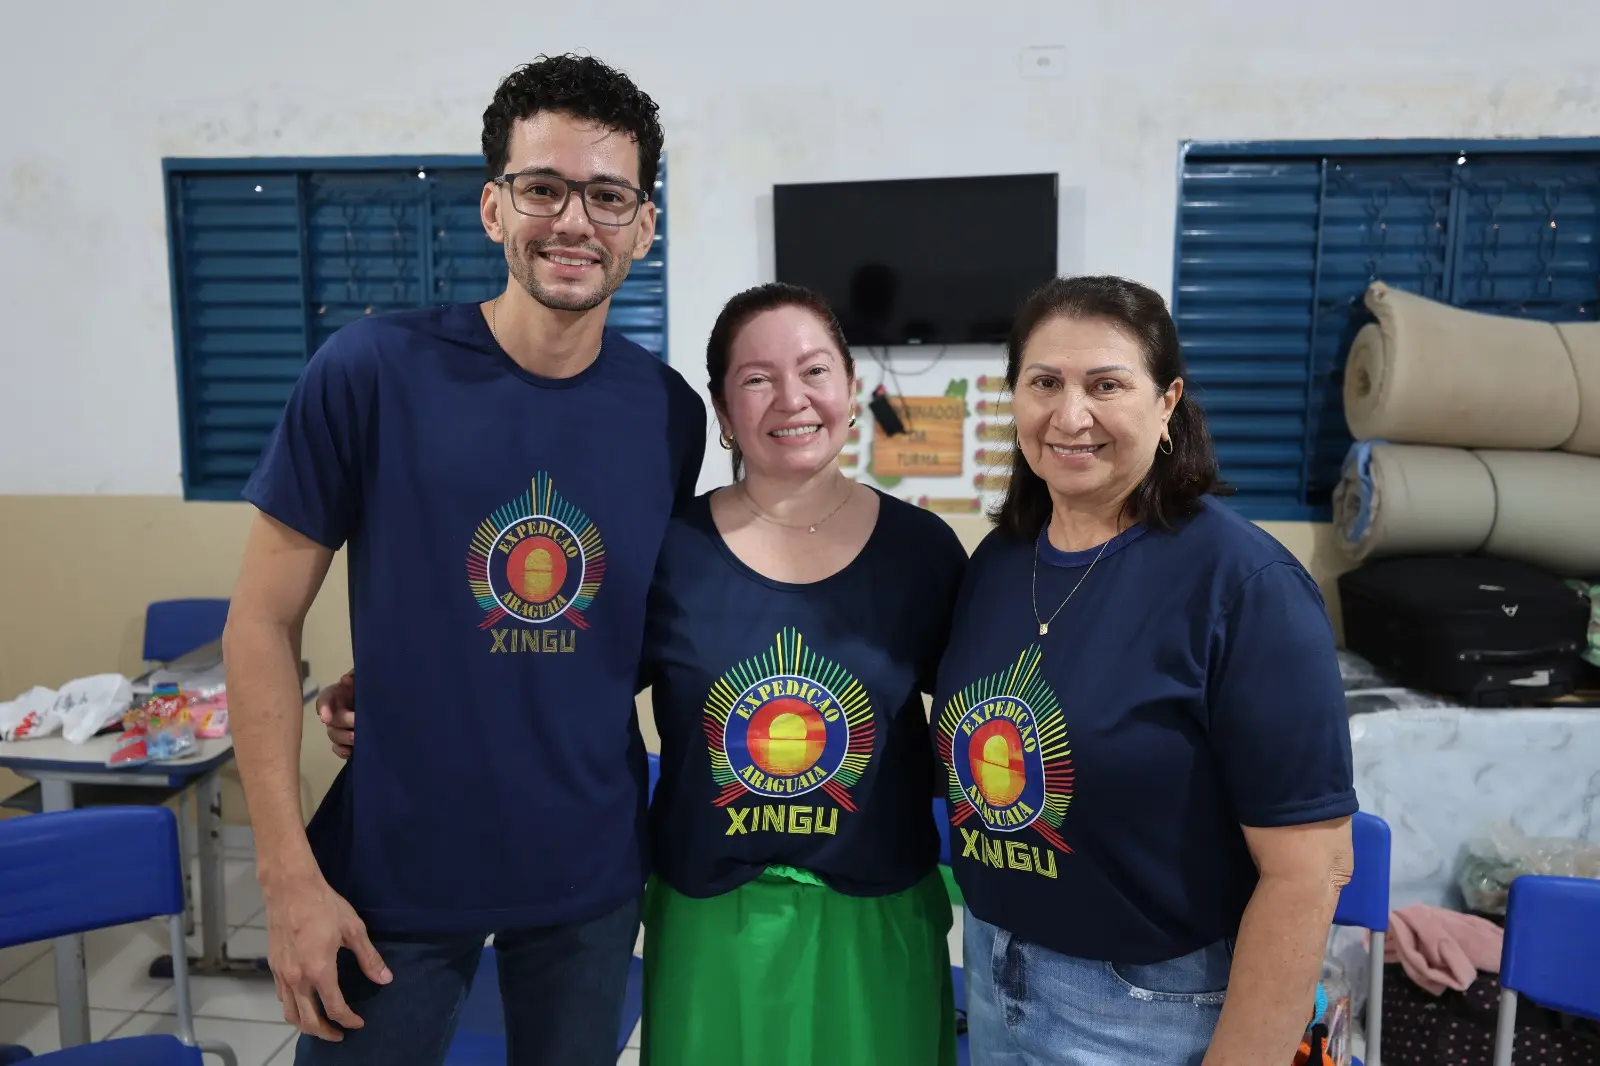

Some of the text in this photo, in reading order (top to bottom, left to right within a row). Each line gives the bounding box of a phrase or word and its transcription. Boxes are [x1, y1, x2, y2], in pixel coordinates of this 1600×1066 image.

[898, 453, 940, 466] TURMA
[500, 591, 568, 618] ARAGUAIA
[490, 629, 576, 653] XINGU
[735, 679, 840, 723] EXPEDIÇÃO
[738, 764, 828, 793] ARAGUAIA
[725, 804, 839, 836] XINGU
[959, 827, 1058, 879] XINGU
